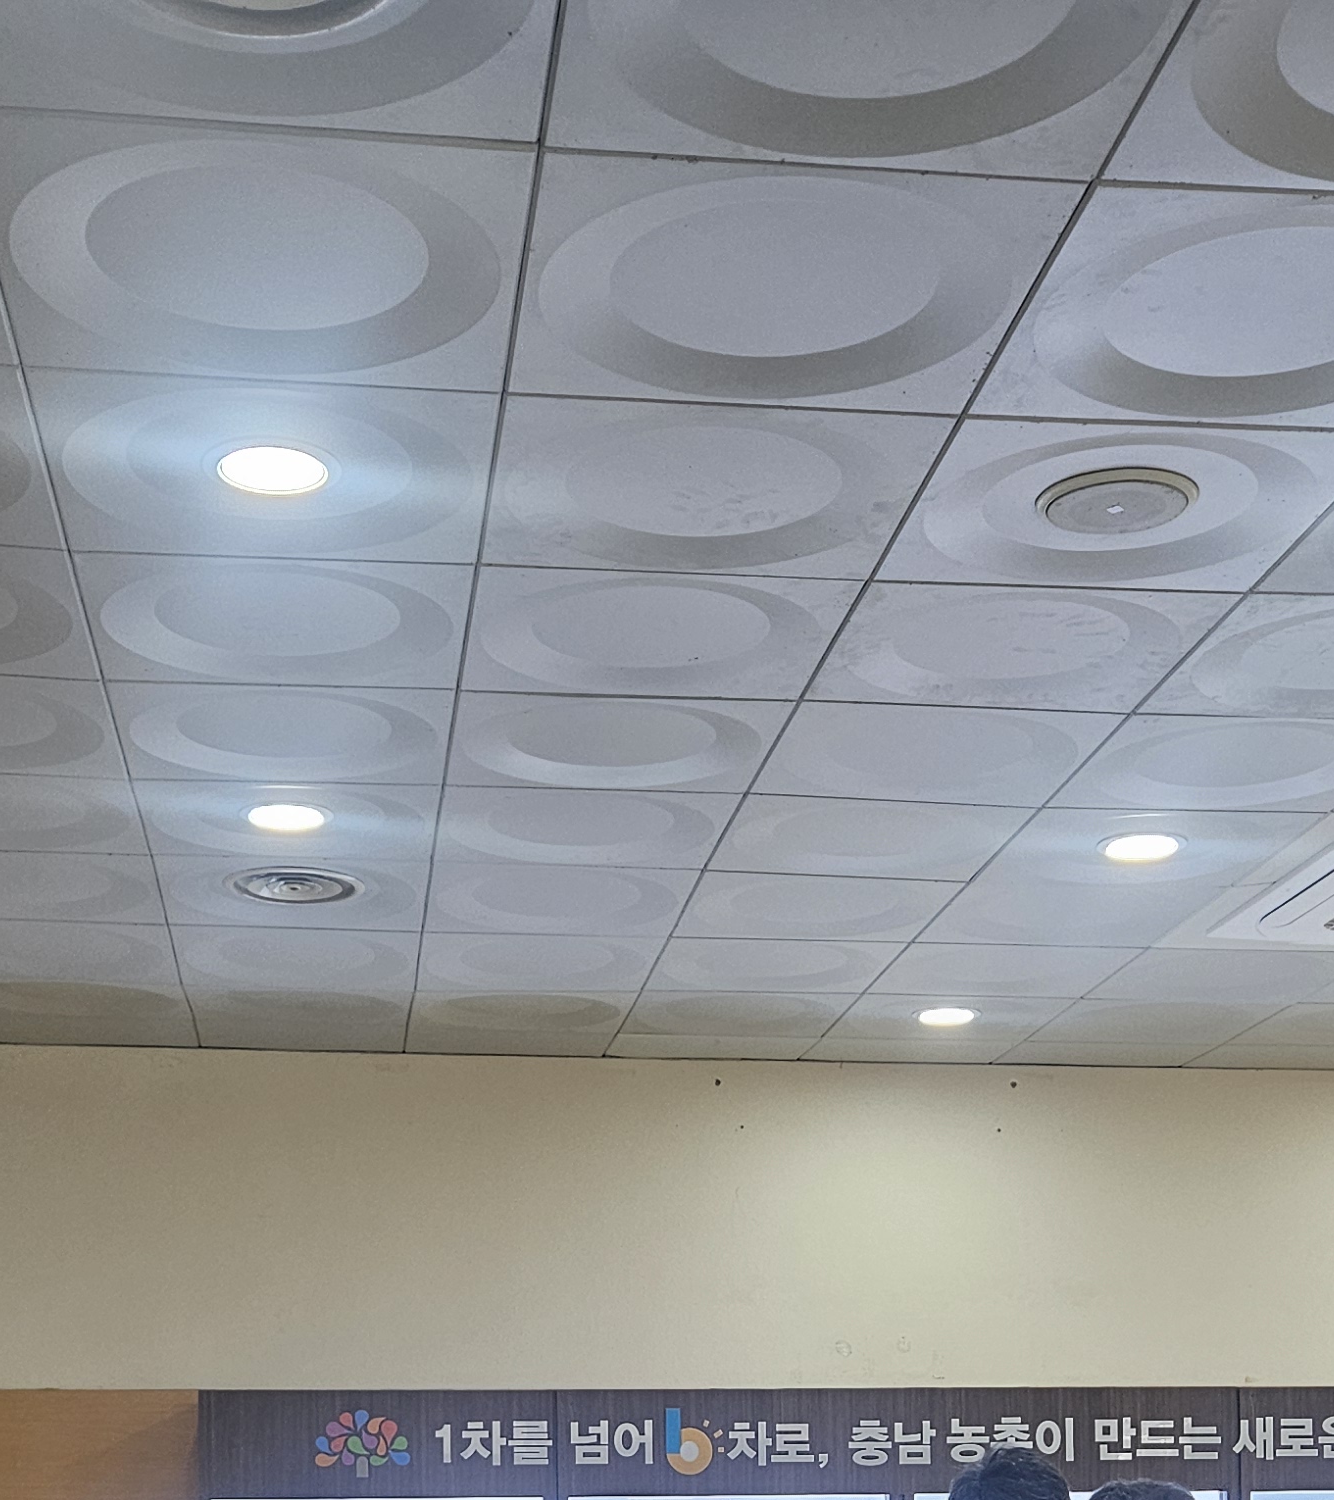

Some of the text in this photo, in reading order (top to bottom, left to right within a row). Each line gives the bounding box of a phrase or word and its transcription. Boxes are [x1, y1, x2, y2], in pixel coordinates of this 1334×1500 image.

[434, 1419, 552, 1466] 1차를
[570, 1419, 654, 1466] 넘어
[848, 1419, 936, 1464] 충남
[947, 1417, 1076, 1462] 농촌이
[1095, 1417, 1222, 1460] 만드는
